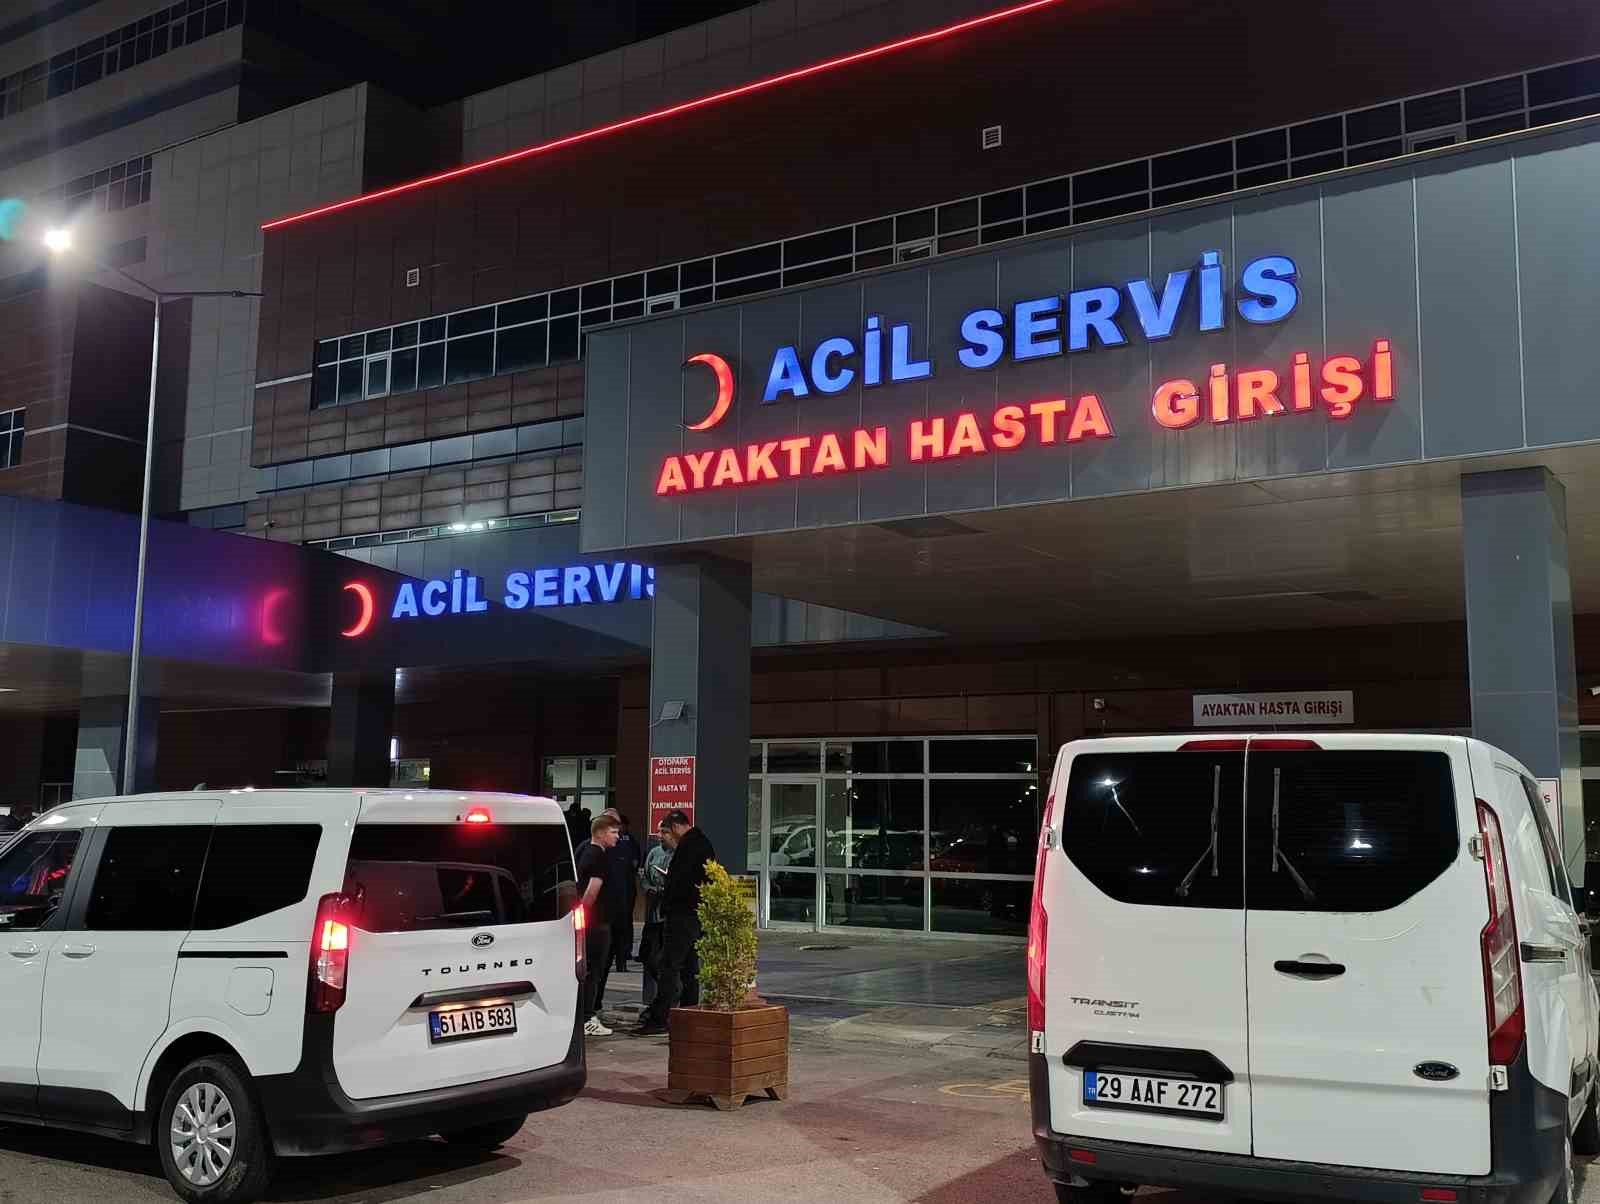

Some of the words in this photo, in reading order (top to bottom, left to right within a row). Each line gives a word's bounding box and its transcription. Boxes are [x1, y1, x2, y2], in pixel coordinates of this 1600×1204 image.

[762, 316, 931, 401] ACİL
[958, 250, 1300, 369] SERVİS
[656, 427, 887, 494] AYAKTAN
[910, 395, 1111, 461] HASTA
[1152, 340, 1393, 428] GİRİŞİ
[391, 568, 488, 618] ACİL
[1201, 702, 1256, 717] AYAKTAN
[1258, 701, 1301, 715] HASTA
[658, 758, 689, 766] OTOPARK
[657, 784, 679, 792] HASTA
[679, 784, 688, 792] VE
[421, 958, 533, 976] TOURNEO
[1070, 996, 1140, 1009] TRANSIT
[440, 1014, 456, 1034] 61
[461, 1010, 485, 1032] AIB
[487, 1007, 512, 1028] 583
[1097, 1075, 1122, 1099] 29
[1130, 1078, 1169, 1104] AAF
[1177, 1083, 1217, 1109] 272
